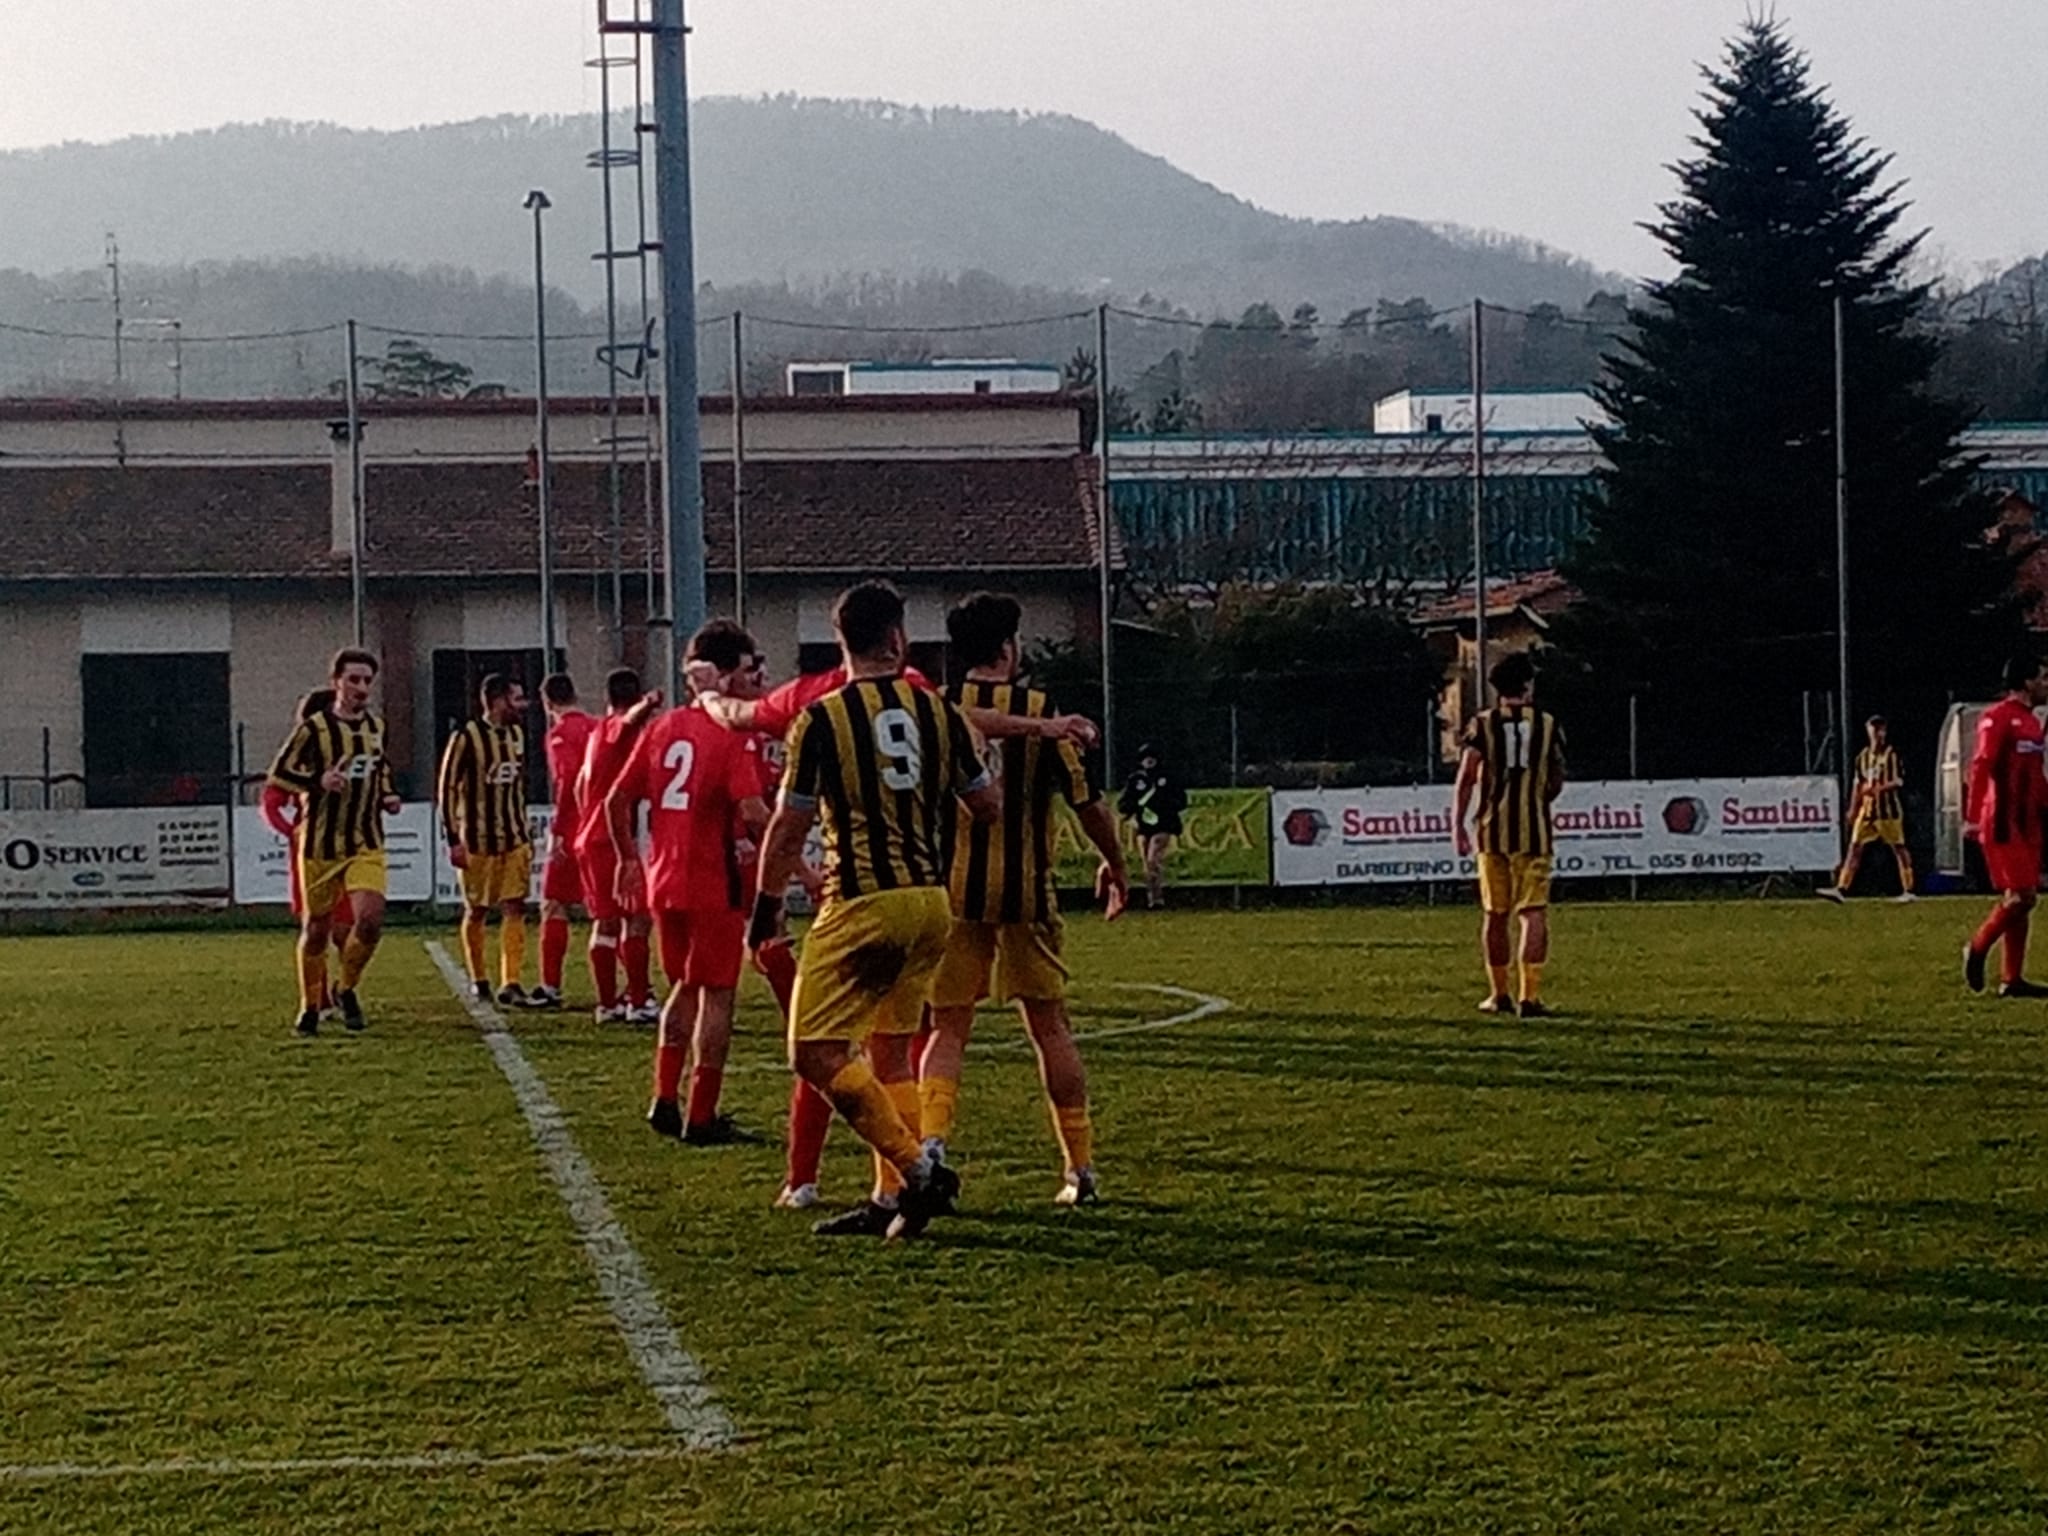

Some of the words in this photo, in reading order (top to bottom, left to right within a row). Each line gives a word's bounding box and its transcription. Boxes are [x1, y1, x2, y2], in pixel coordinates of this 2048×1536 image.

[876, 708, 922, 790] 9
[1503, 720, 1530, 768] 11
[661, 739, 694, 810] 2
[1343, 807, 1452, 836] Santini
[1553, 804, 1644, 830] antini
[1721, 797, 1831, 825] Santini
[43, 845, 149, 864] SERVICE
[1336, 860, 1454, 877] BARBERINO
[1650, 854, 1687, 868] 055
